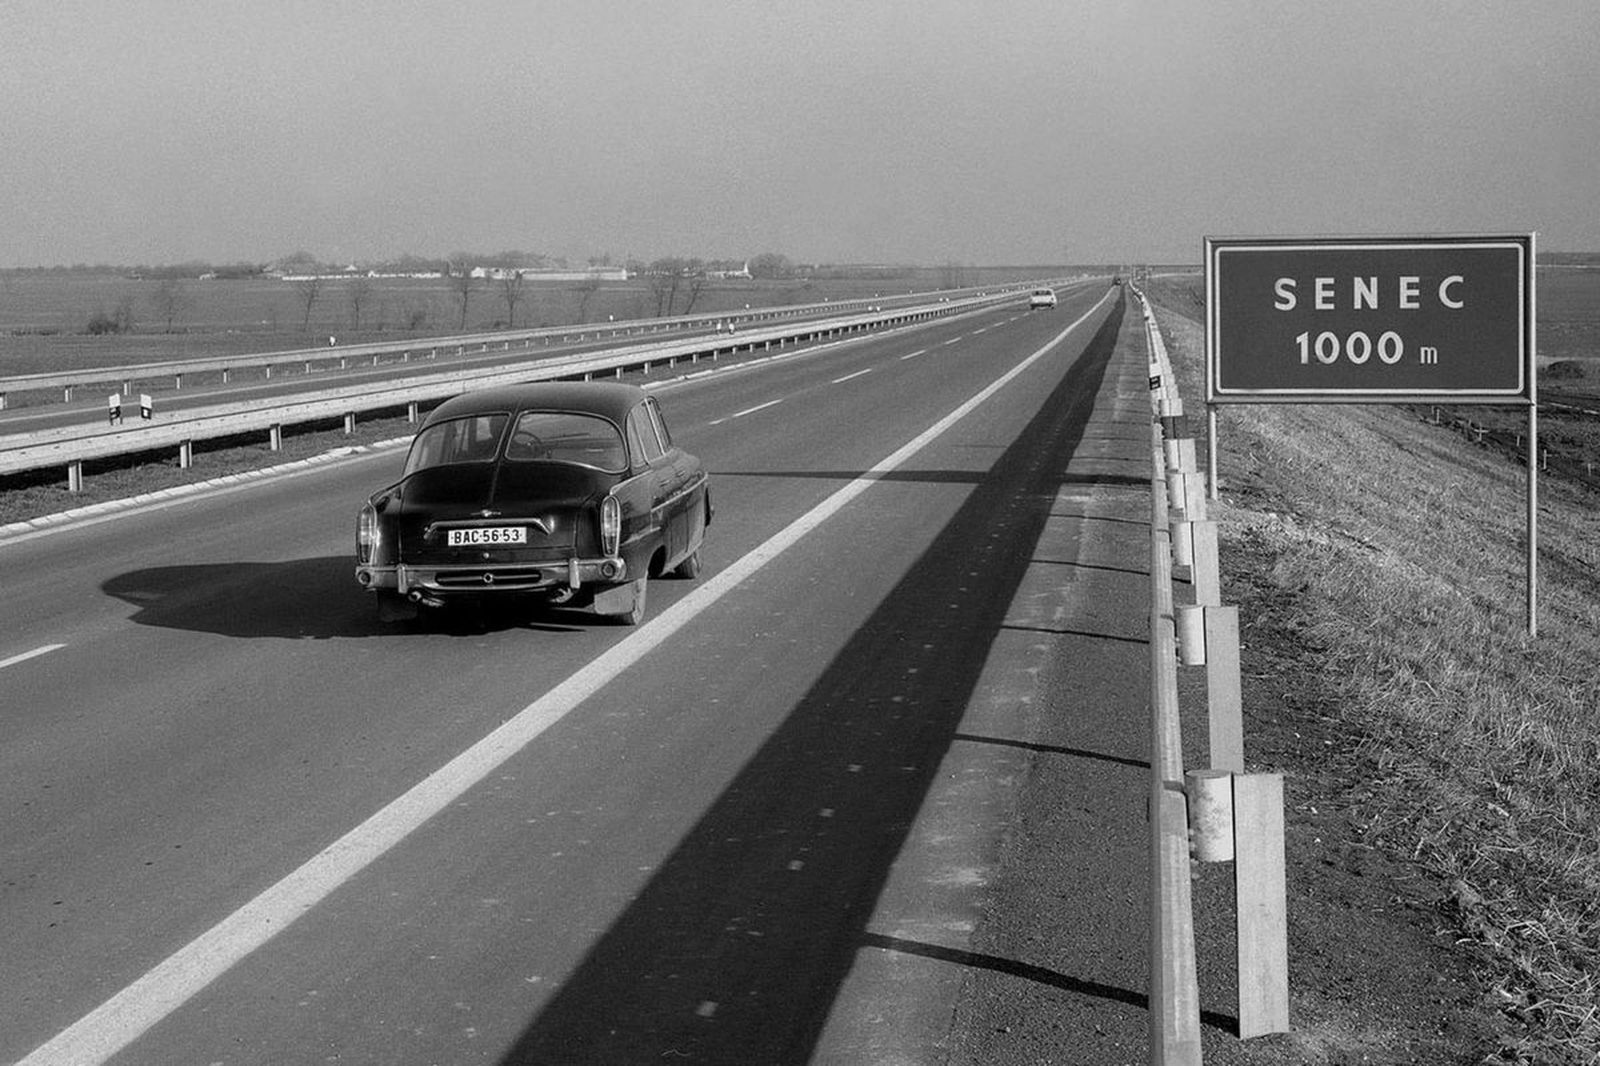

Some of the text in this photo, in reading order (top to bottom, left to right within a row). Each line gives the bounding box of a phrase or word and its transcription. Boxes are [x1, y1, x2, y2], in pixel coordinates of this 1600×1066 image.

[1274, 275, 1464, 311] SENEC
[1295, 330, 1438, 365] 1000 m
